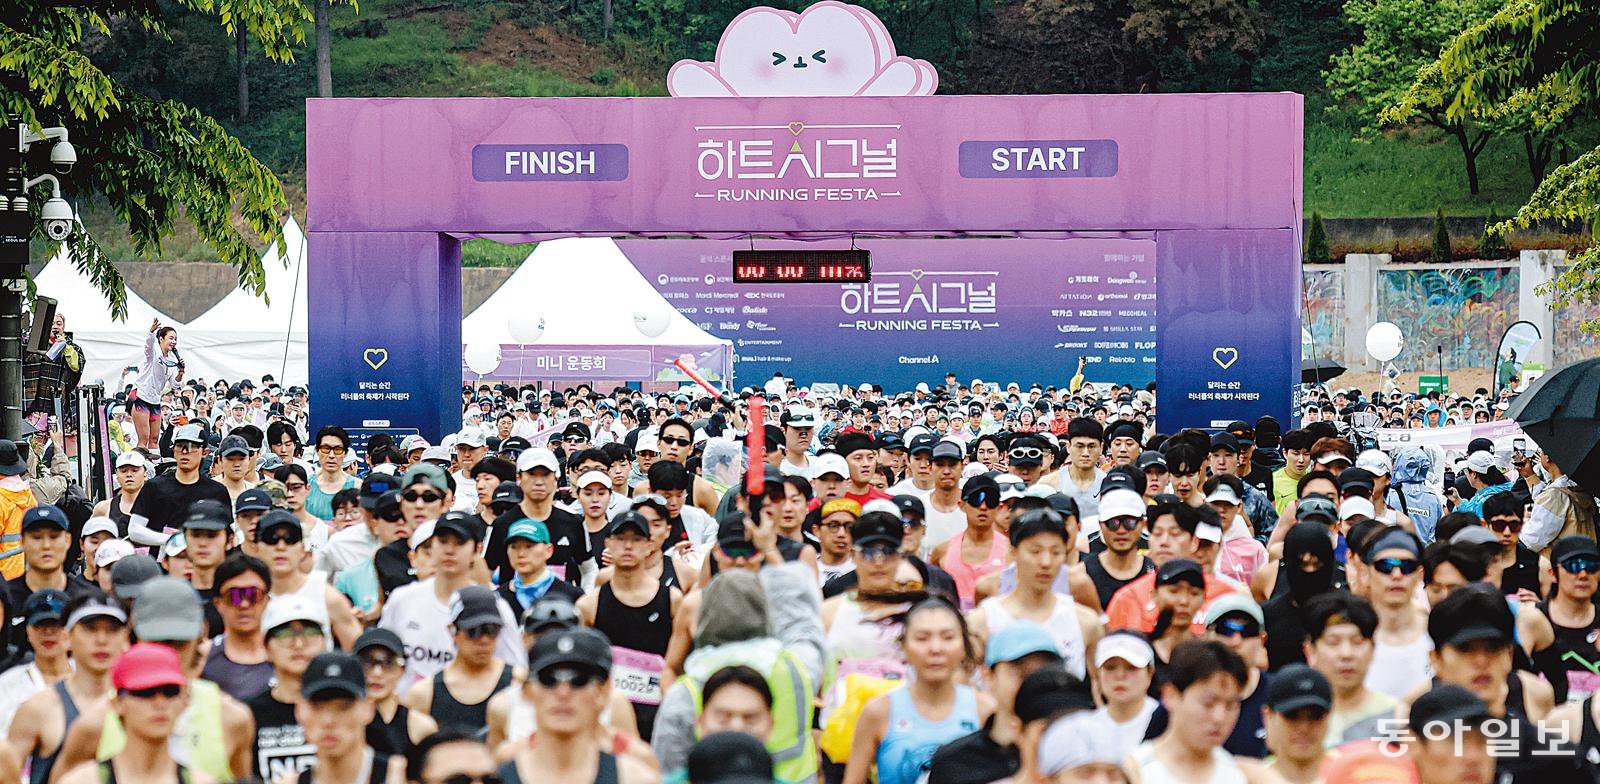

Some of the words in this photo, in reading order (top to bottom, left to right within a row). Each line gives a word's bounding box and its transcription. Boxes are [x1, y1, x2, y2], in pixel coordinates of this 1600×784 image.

[505, 151, 596, 175] FINISH
[697, 138, 898, 180] 하트시그널
[991, 147, 1086, 172] START
[717, 188, 808, 202] RUNNING
[815, 188, 879, 201] FESTA
[841, 282, 996, 314] 하트시그널
[856, 320, 928, 330] RUNNING
[931, 320, 982, 330] FESTA
[537, 355, 562, 371] 미니
[567, 355, 606, 371] 운동회
[1208, 381, 1227, 389] 달리는
[1228, 381, 1241, 389] 순간
